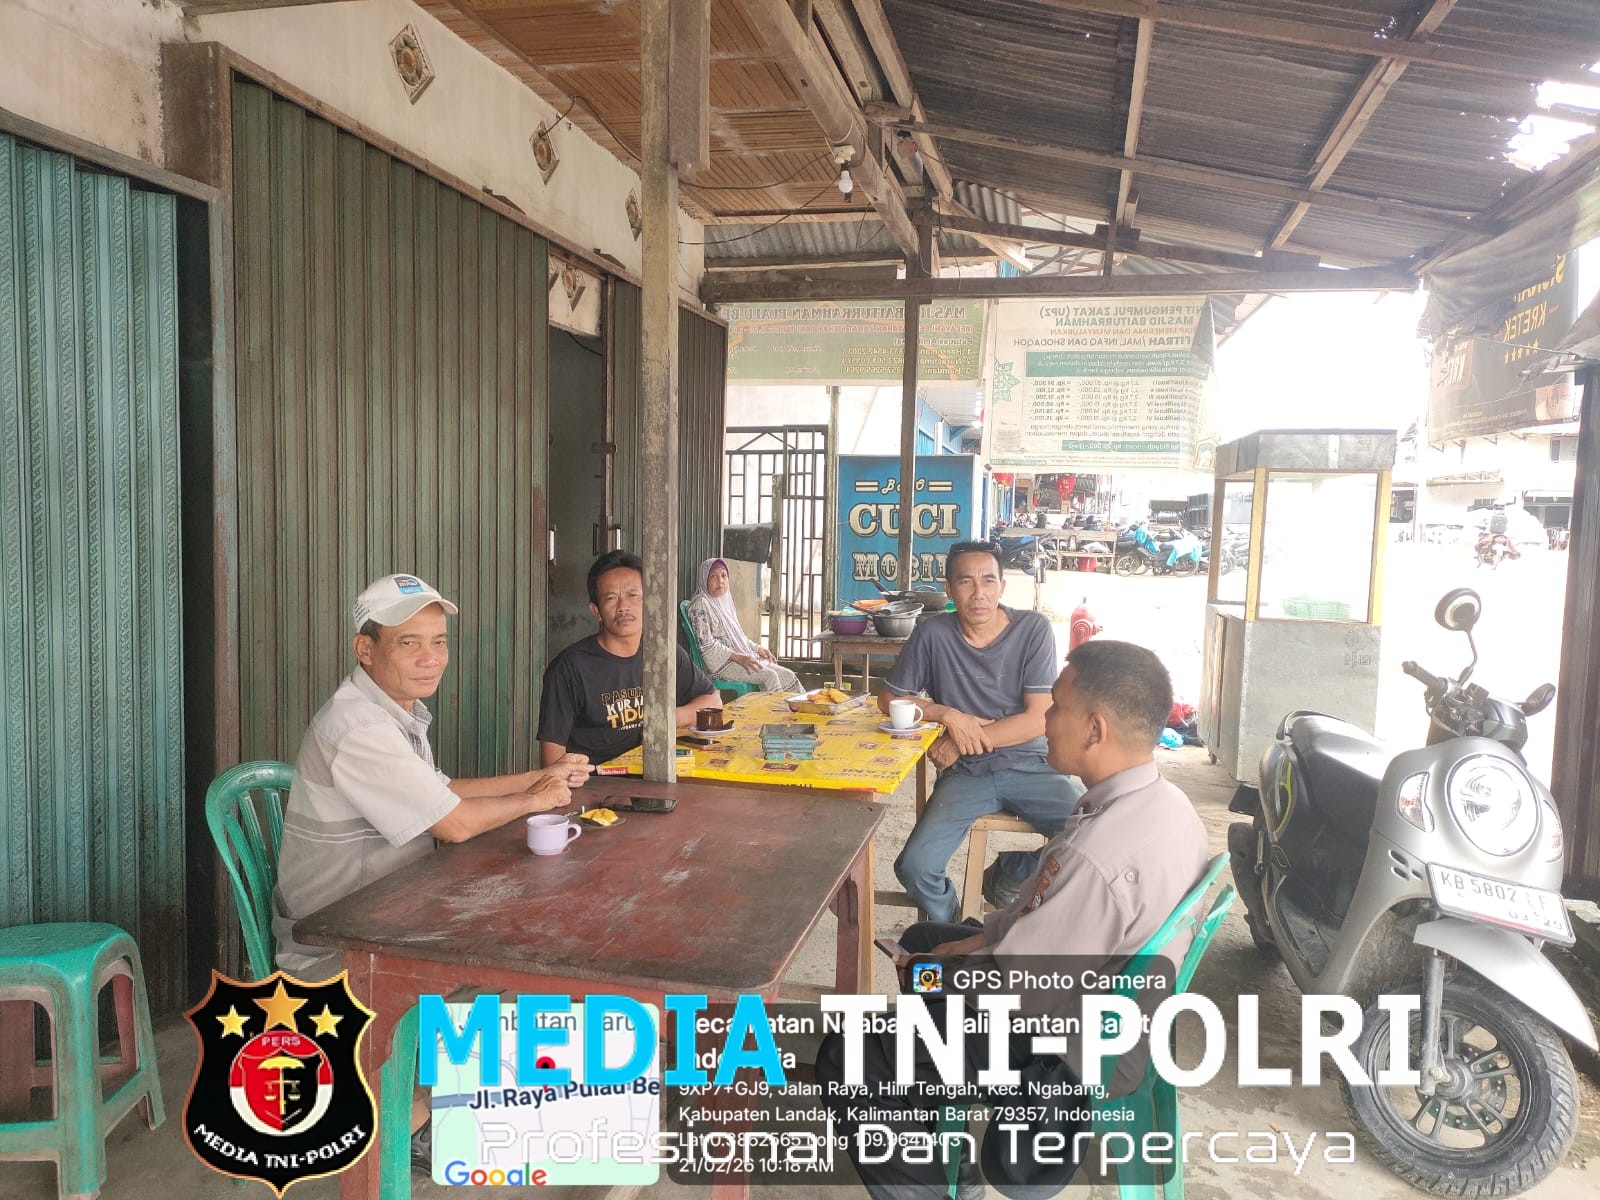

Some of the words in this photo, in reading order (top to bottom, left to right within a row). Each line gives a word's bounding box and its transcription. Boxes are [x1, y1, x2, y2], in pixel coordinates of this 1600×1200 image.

[850, 504, 959, 537] CUCI
[1440, 871, 1465, 890] KB
[1470, 877, 1517, 903] 5802
